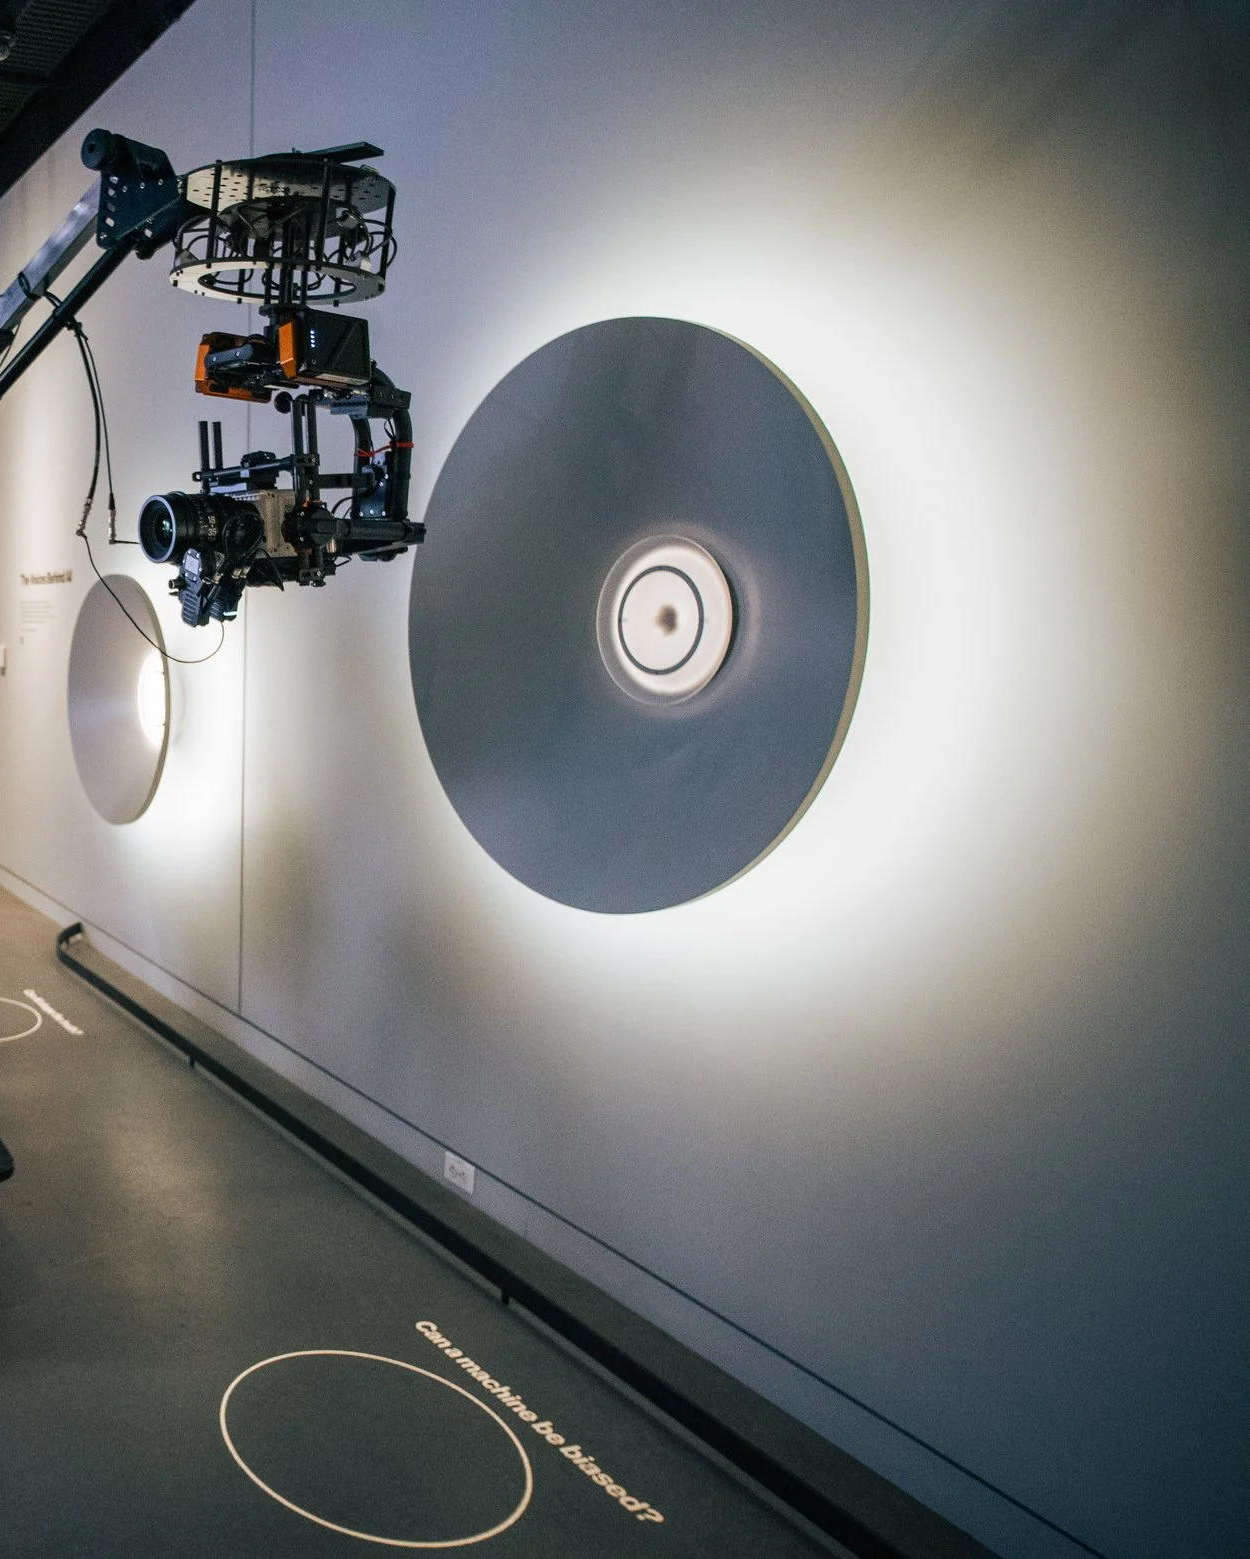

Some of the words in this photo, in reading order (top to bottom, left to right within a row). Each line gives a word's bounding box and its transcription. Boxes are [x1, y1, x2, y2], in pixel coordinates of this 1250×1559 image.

[207, 515, 216, 524] 18
[207, 528, 217, 536] 35
[415, 1320, 451, 1349] Can
[444, 1348, 464, 1359] a
[456, 1357, 538, 1422] machine
[532, 1421, 565, 1446] be
[560, 1445, 665, 1523] biased?
